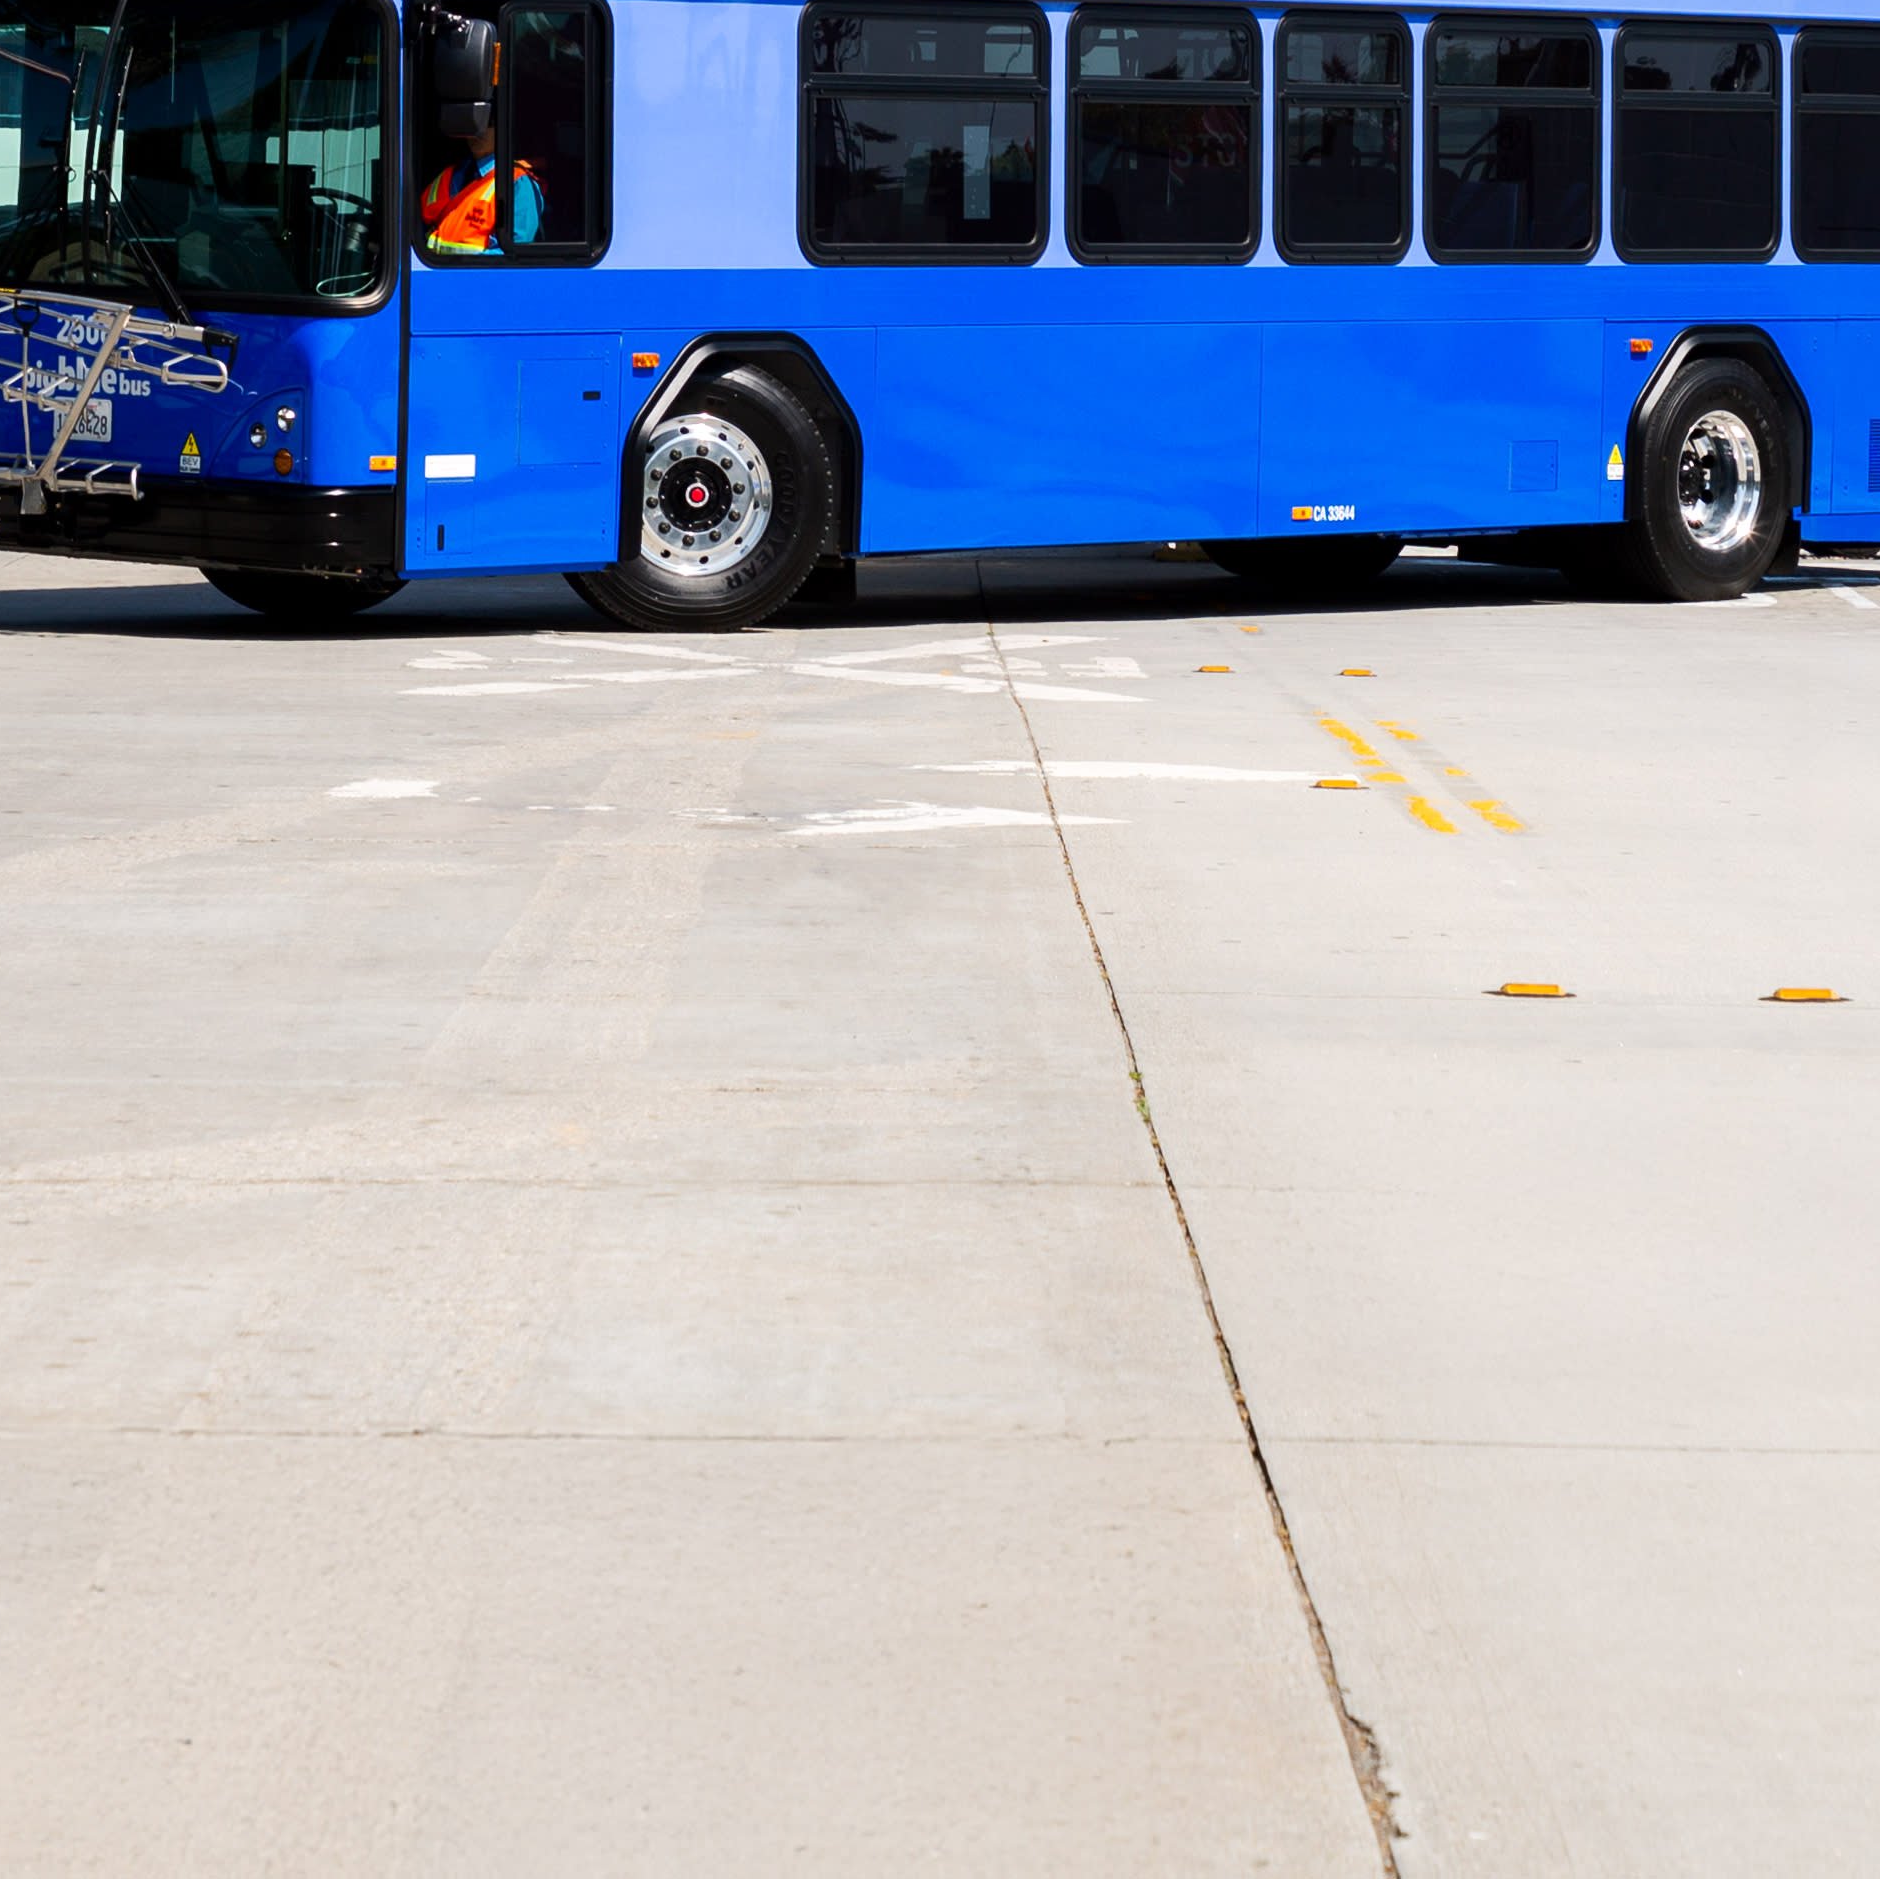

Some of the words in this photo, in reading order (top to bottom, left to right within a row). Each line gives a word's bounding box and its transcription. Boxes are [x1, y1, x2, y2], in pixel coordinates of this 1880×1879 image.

[56, 314, 110, 345] 250
[119, 372, 151, 397] bus
[1313, 505, 1327, 522] CA
